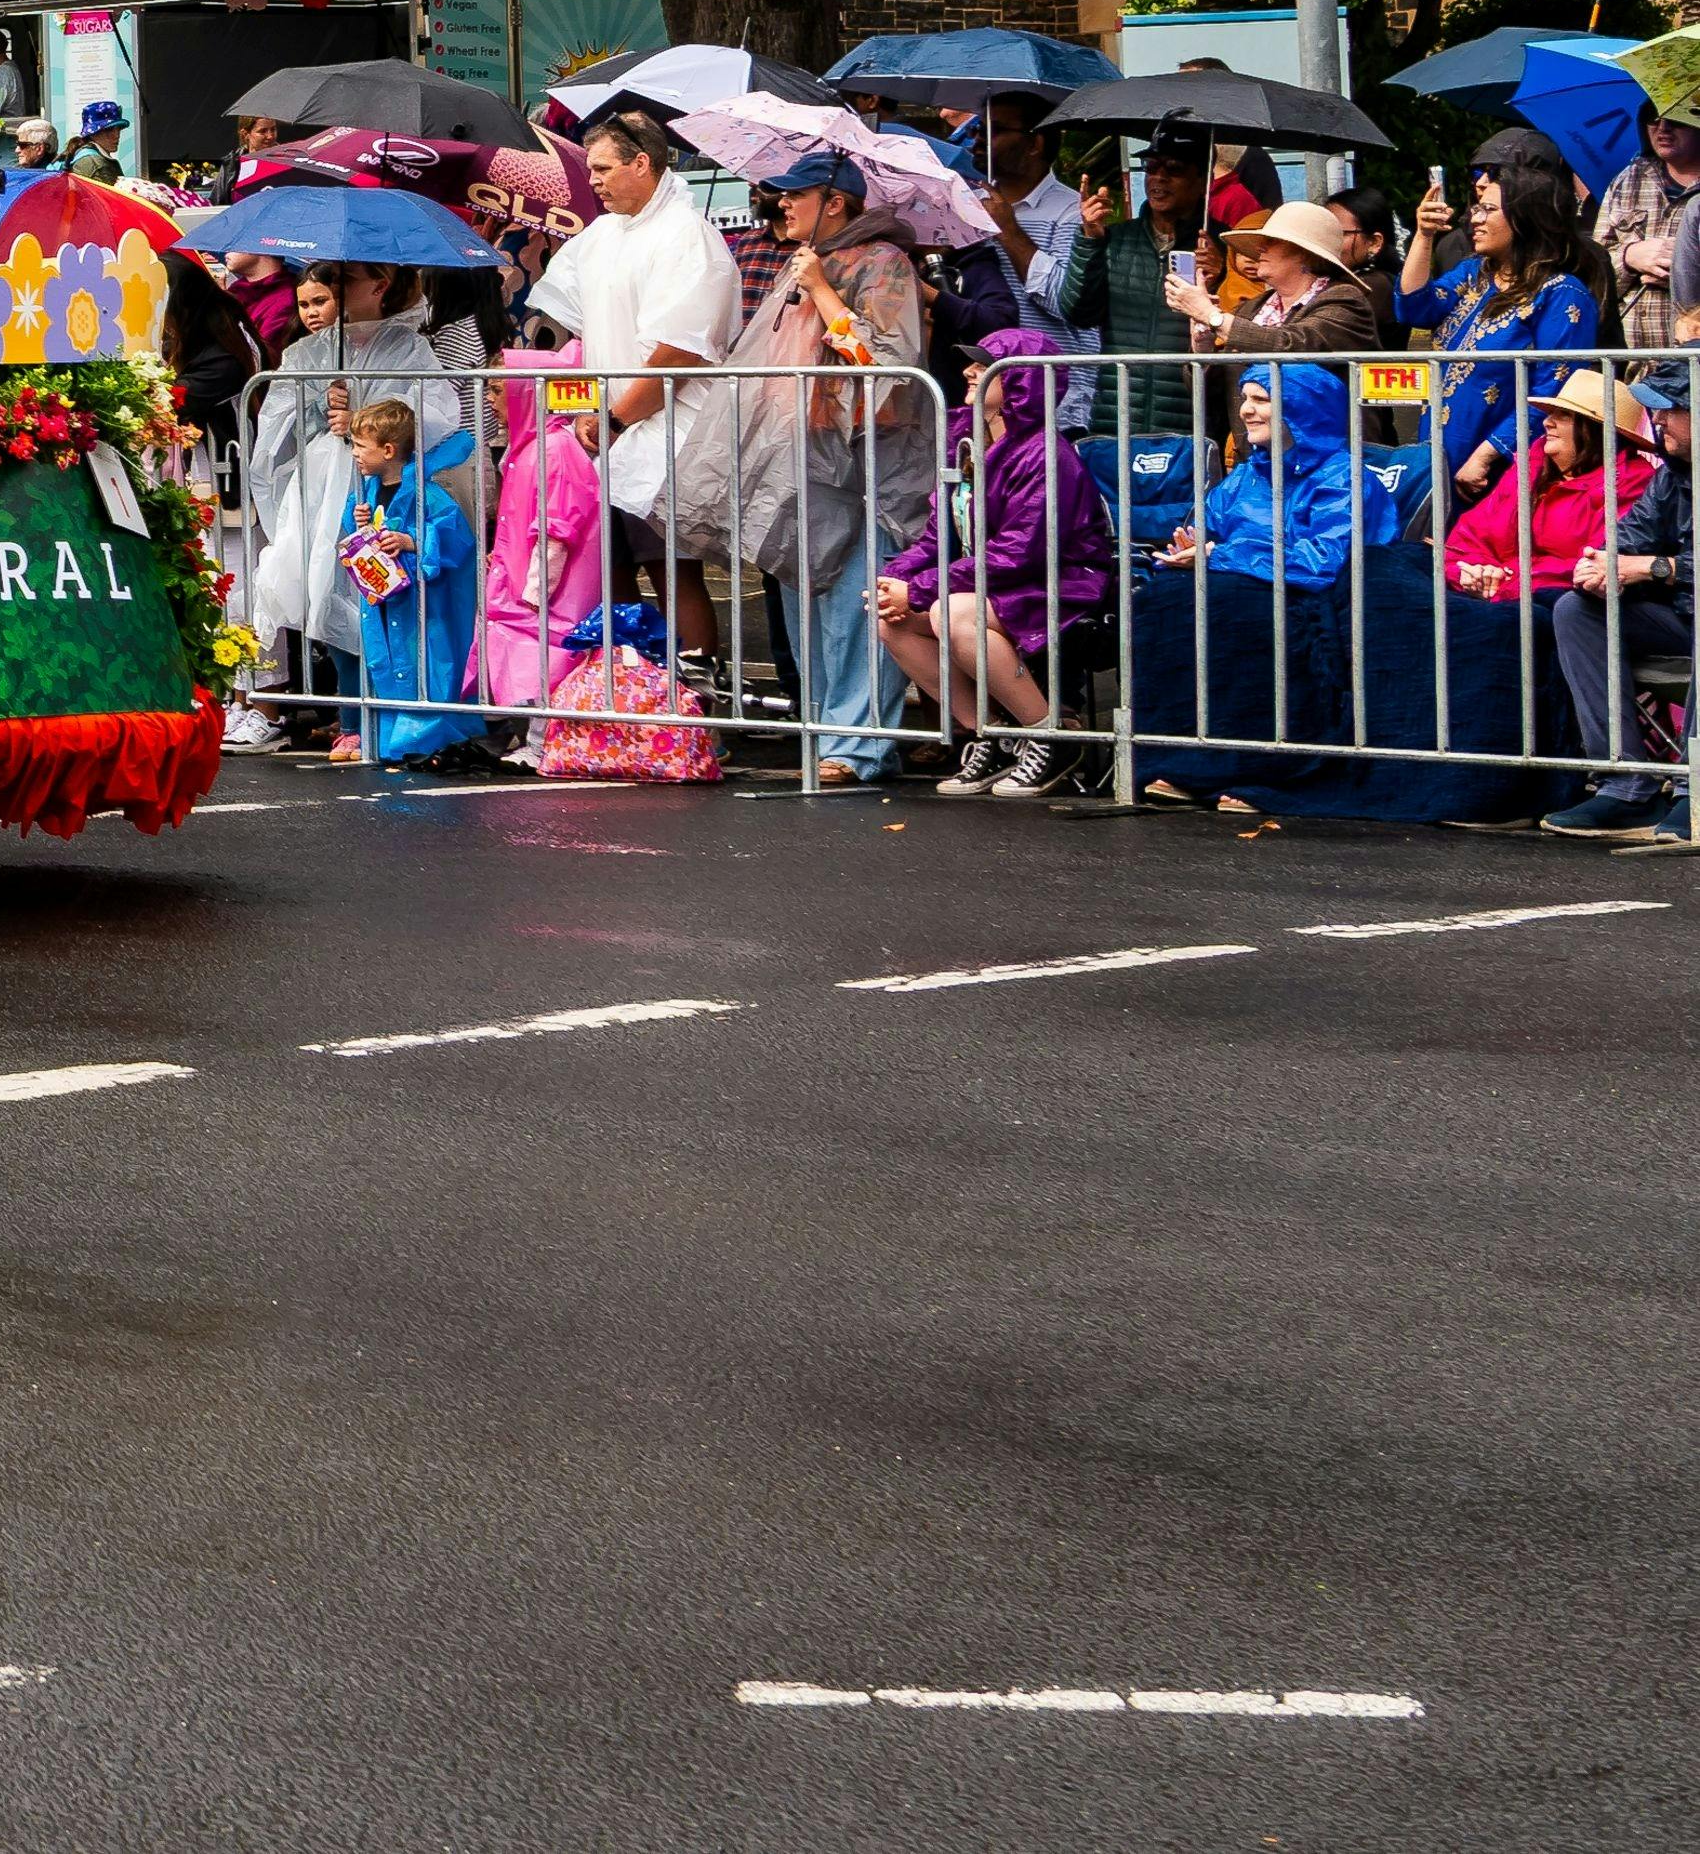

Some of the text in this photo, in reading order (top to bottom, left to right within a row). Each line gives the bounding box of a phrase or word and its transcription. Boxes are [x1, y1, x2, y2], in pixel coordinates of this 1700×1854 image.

[446, 0, 477, 11] Vegan
[73, 19, 114, 34] SUGARS
[447, 23, 501, 34] Gluten Free
[448, 46, 500, 56] Wheat Free
[448, 68, 488, 79] Egg Free
[356, 153, 422, 180] INFRNO
[464, 201, 508, 219] TOUCH
[467, 183, 584, 235] QLD
[1369, 368, 1416, 388] TFH
[553, 381, 590, 400] TFH
